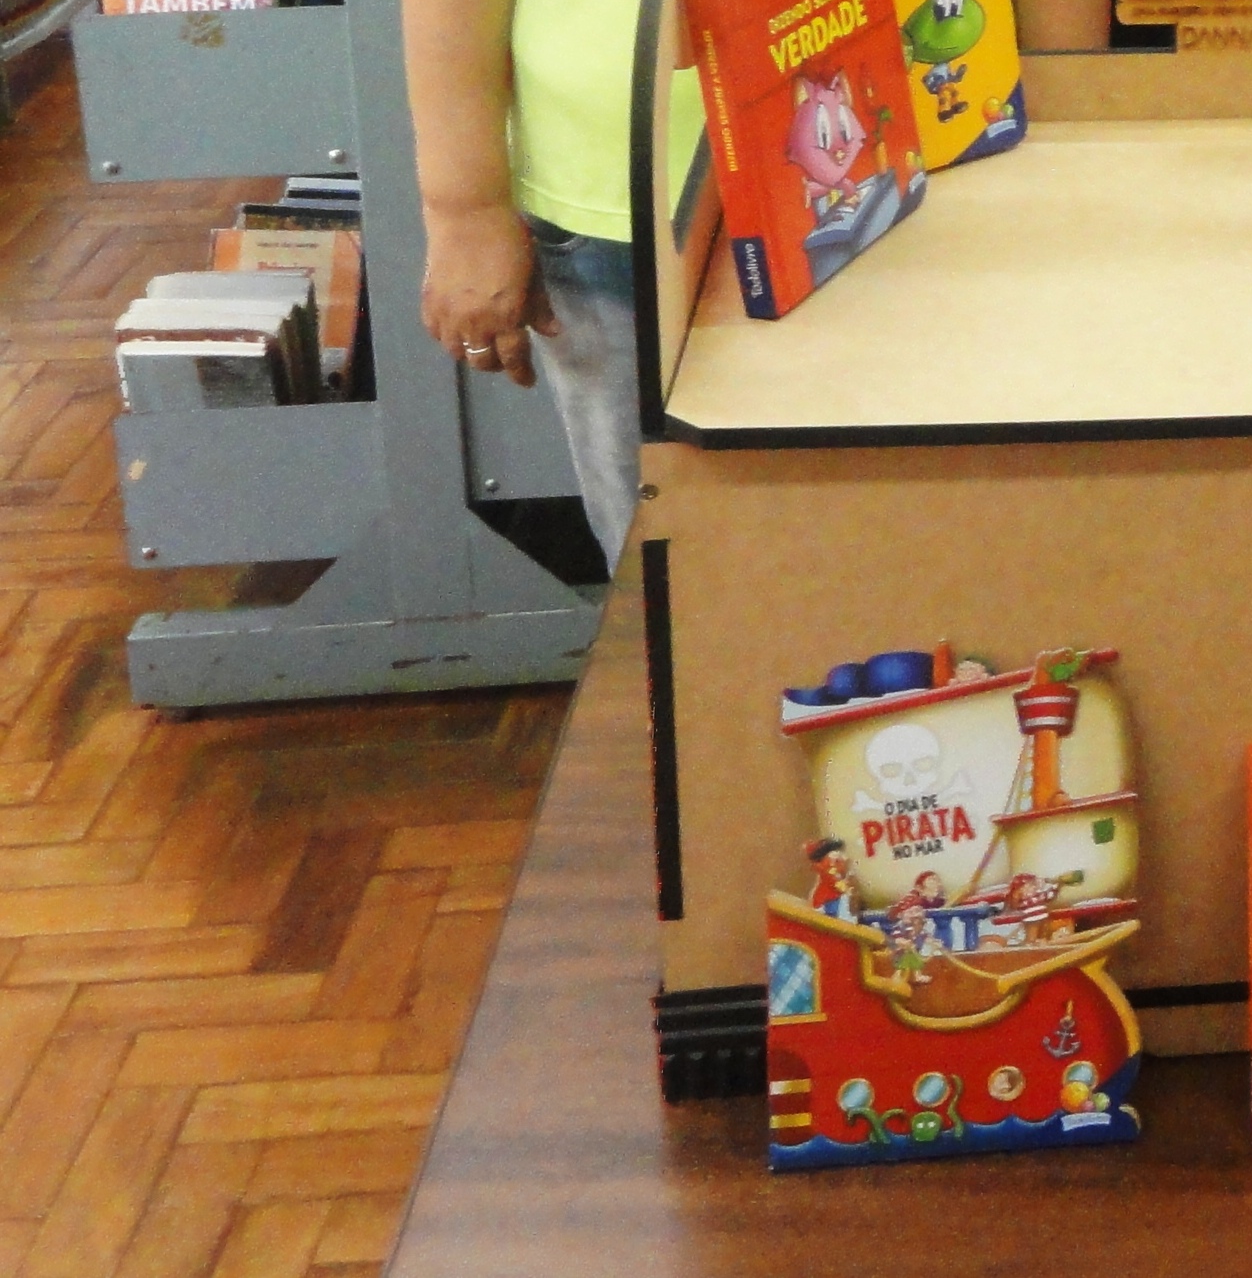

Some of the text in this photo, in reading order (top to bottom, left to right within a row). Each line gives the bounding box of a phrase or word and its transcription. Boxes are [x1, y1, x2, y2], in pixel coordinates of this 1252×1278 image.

[921, 793, 938, 810] DE
[861, 804, 977, 859] PIRATA
[914, 839, 944, 857] MAR
